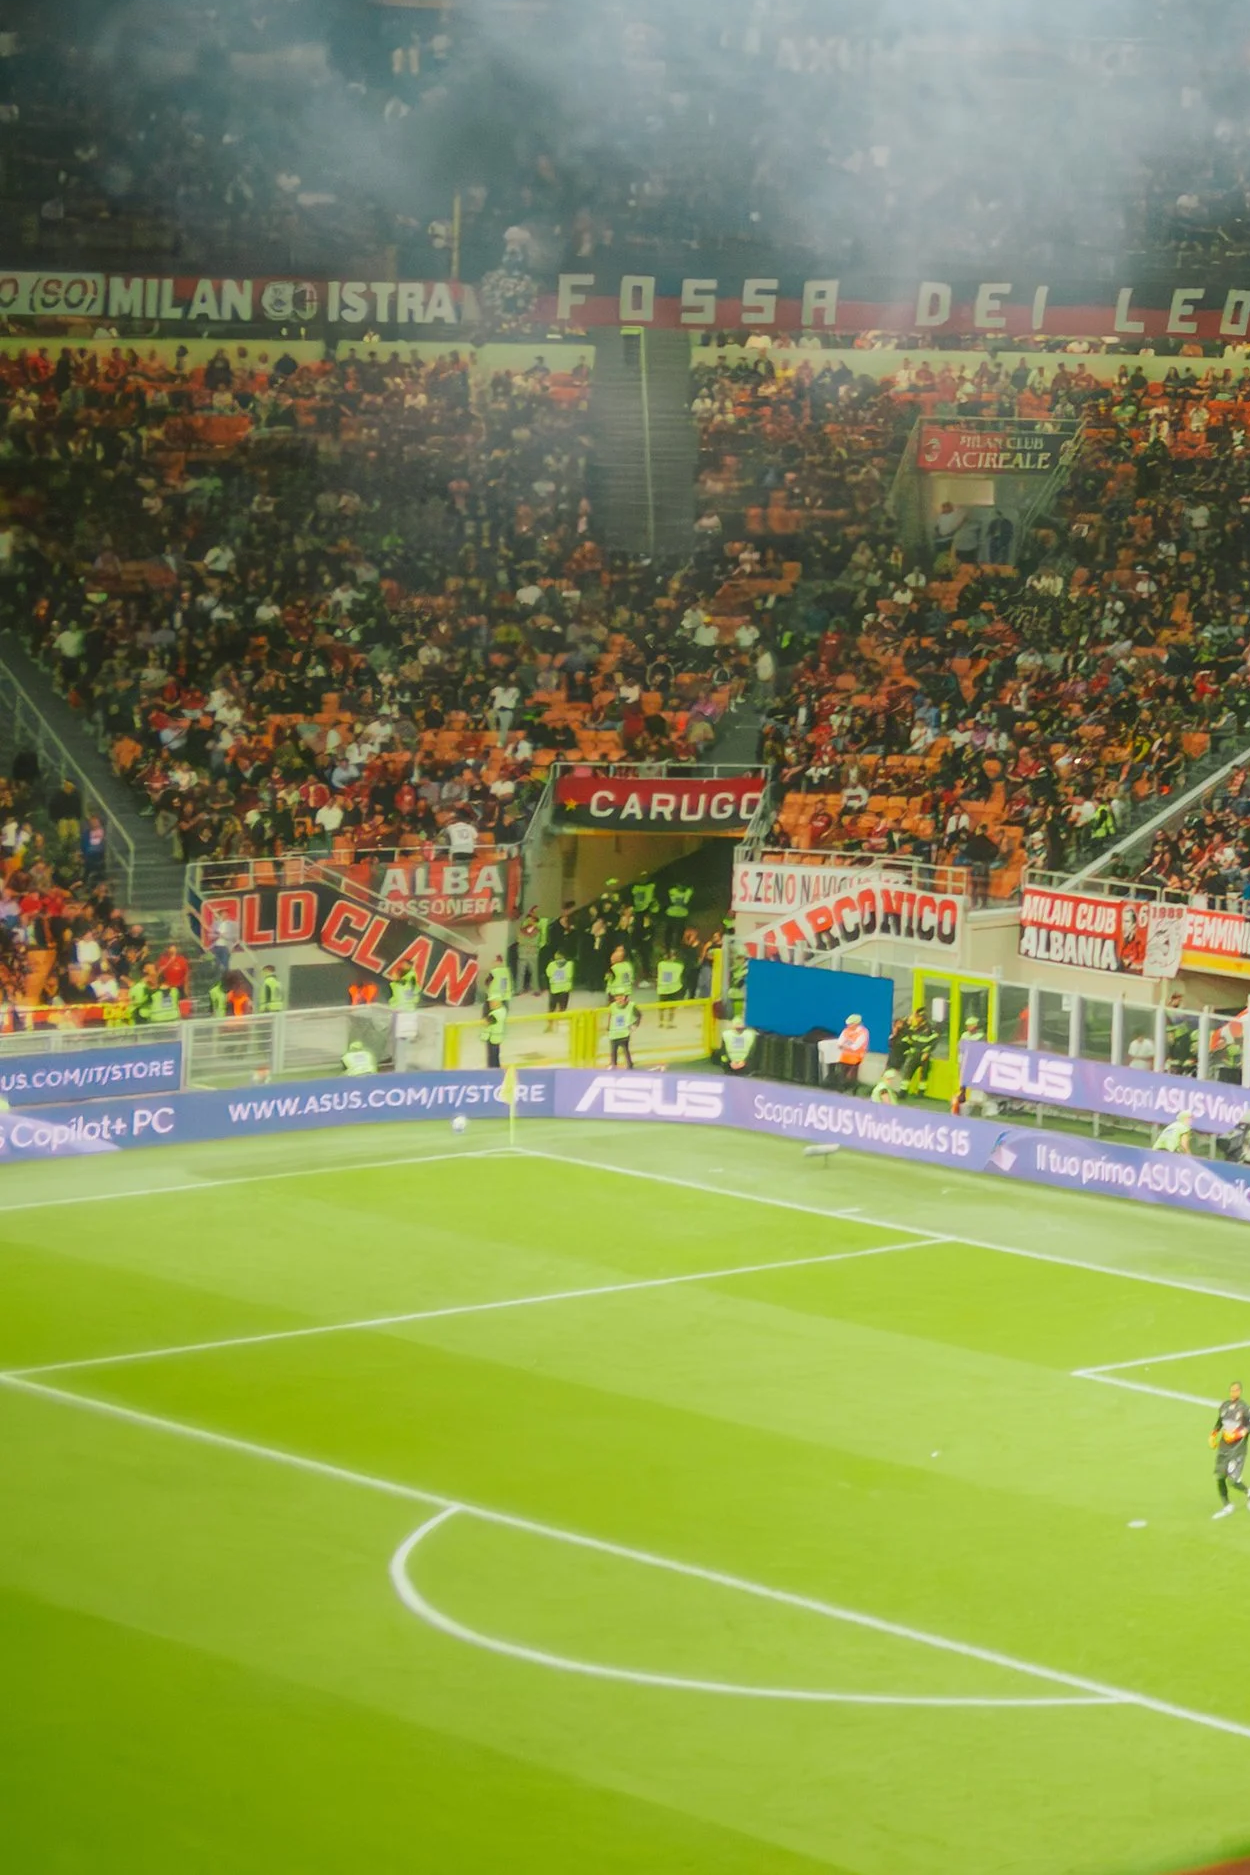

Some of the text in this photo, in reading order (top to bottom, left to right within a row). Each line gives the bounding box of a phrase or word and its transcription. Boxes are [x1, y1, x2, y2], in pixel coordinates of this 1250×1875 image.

[29, 277, 98, 312] (SO)
[108, 276, 253, 321] MILAN
[327, 281, 457, 324] ISTRA
[557, 272, 840, 325] FOSSA
[915, 281, 1049, 331] DEI
[1006, 437, 1044, 450] CLUB
[589, 789, 764, 822] CARUGO
[380, 865, 505, 897] ALBA
[1021, 894, 1118, 935] MILAN CLUB
[320, 899, 480, 1007] CLAN
[1020, 926, 1120, 972] ALBANIA
[971, 1049, 1074, 1102] ASUS
[1102, 1075, 1151, 1112] Scopri
[1154, 1085, 1206, 1119] ASUS
[574, 1075, 725, 1121] ASUS
[132, 1106, 176, 1137] PC
[753, 1093, 971, 1157] Scopri ASUS Vivobook S 15
[1047, 1147, 1080, 1177] tuo
[1081, 1155, 1137, 1187] primo
[1137, 1163, 1193, 1198] ASUS
